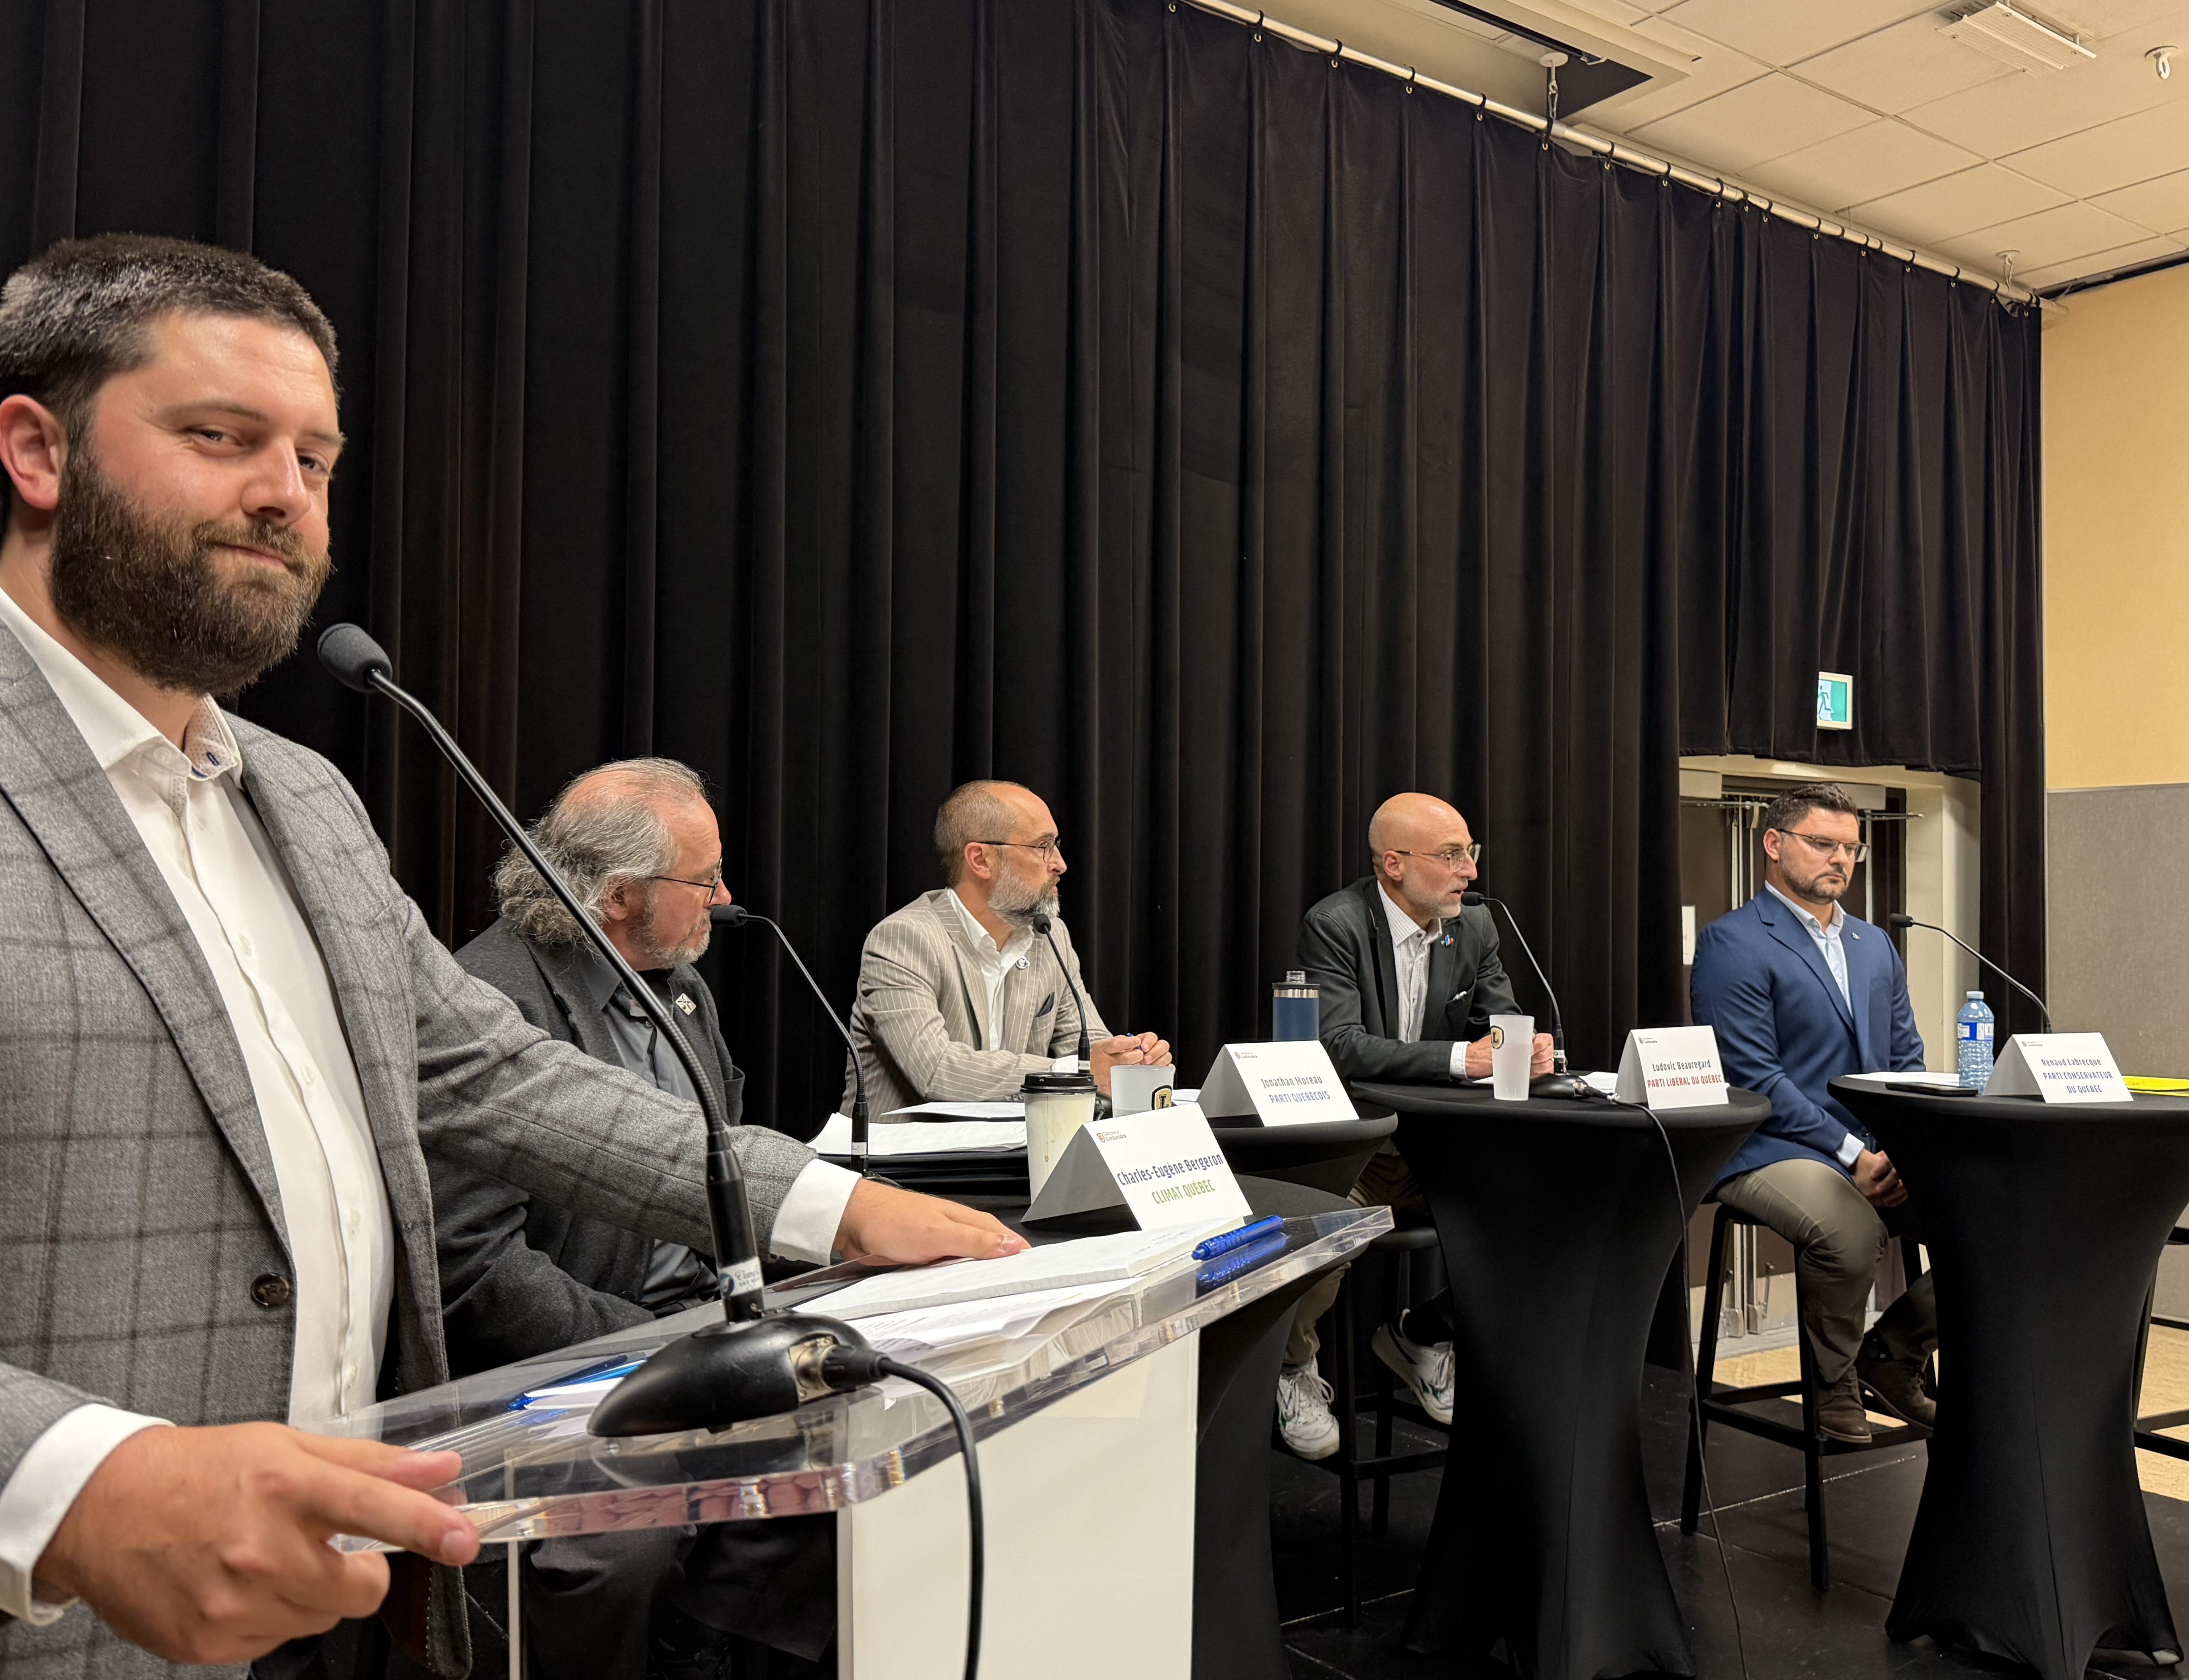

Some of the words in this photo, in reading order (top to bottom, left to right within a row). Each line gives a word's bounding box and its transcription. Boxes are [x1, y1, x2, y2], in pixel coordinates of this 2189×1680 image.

[1652, 1061, 1676, 1071] Ludovic
[1677, 1059, 1711, 1070] Beauregard
[2067, 1058, 2102, 1067] Labrecque
[1647, 1078, 1666, 1088] PARTI
[1666, 1075, 1690, 1087] LIBÉRAL
[1691, 1076, 1699, 1085] DU
[1700, 1073, 1722, 1085] QUÉBEC
[2063, 1071, 2113, 1079] CONSERVATEUR
[1261, 1077, 1295, 1089] Jonathan
[1294, 1076, 1323, 1085] Moreau
[1269, 1093, 1292, 1103] PARTI
[1291, 1091, 1331, 1103] QUÉBÉCOIS
[1117, 1162, 1186, 1185] Charles-Eugène
[1184, 1154, 1224, 1171] Bergeron
[1151, 1186, 1184, 1204] CLIMAT
[1182, 1179, 1215, 1198] QUÉBEC
